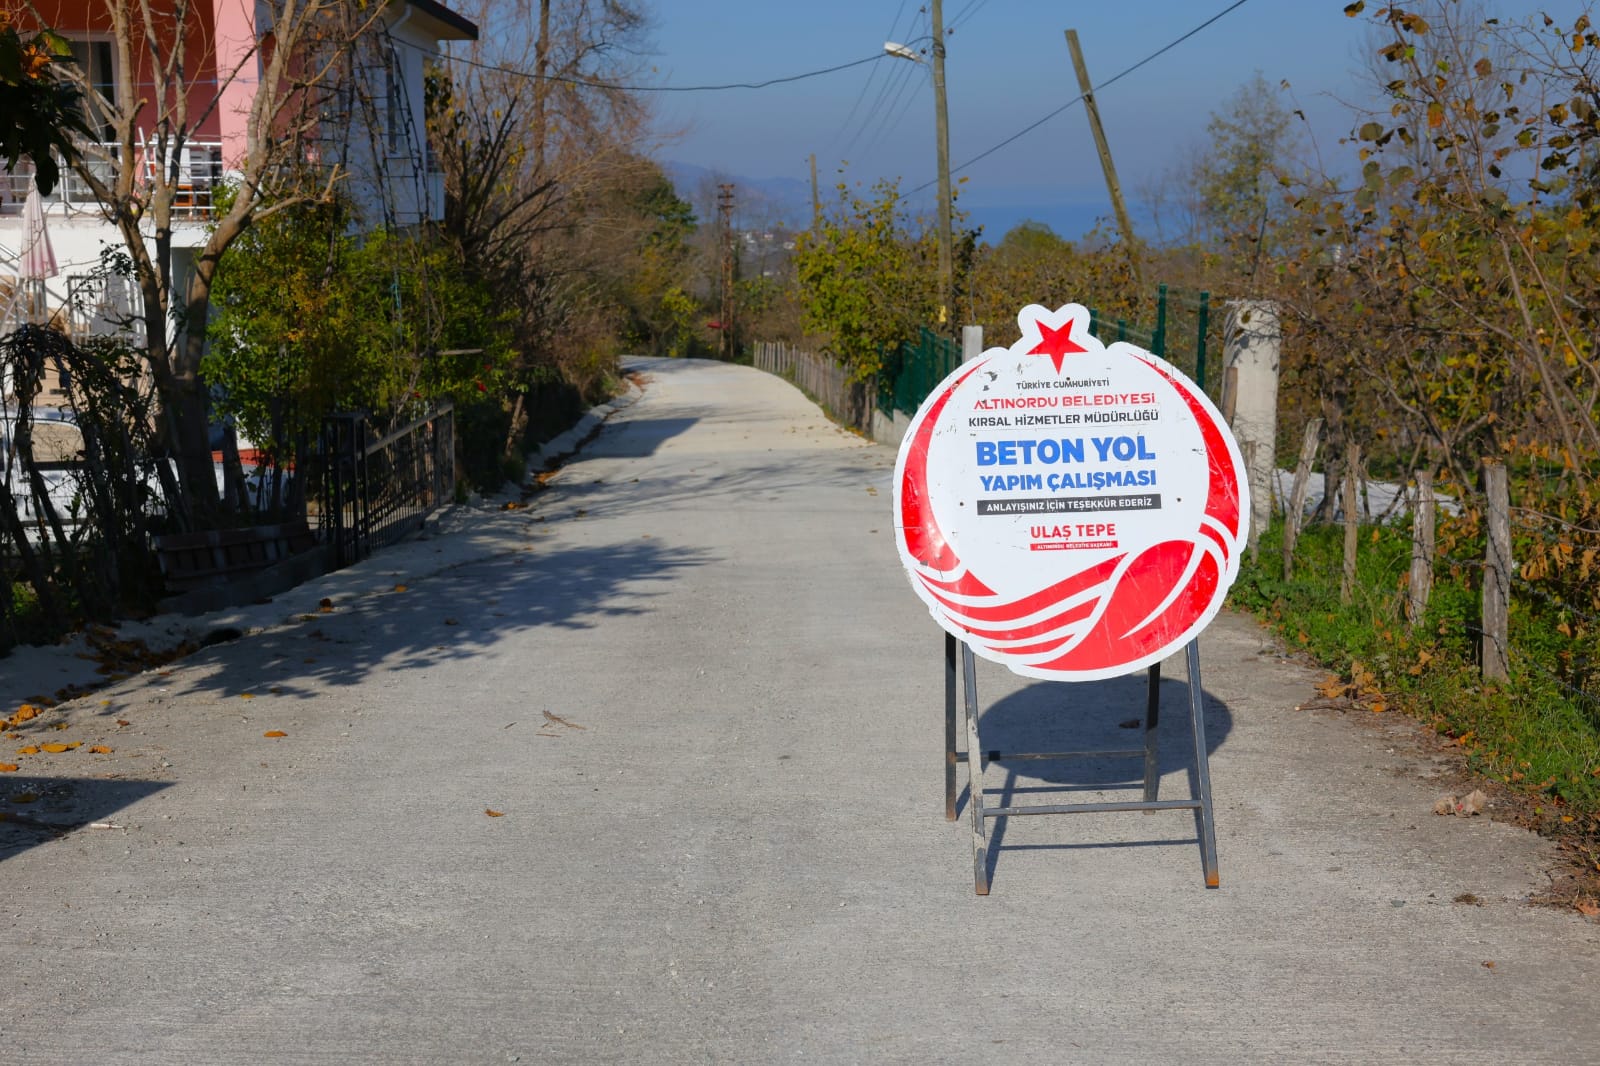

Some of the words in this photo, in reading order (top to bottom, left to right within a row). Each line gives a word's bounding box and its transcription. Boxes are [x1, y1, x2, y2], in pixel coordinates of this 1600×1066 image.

[1017, 380, 1050, 389] TÜRKİYE
[1054, 379, 1109, 388] CUMHURİYETİ
[974, 396, 1057, 409] ALTINORDU
[1063, 393, 1155, 406] BELEDİYESİ
[969, 416, 1011, 427] KIRSAL
[1015, 413, 1080, 425] HİZMETLER
[1084, 410, 1159, 423] MÜDÜRLÜĞÜ
[976, 439, 1084, 466] BETON
[1091, 436, 1156, 461] YOL
[980, 474, 1042, 491] YAPIM
[1047, 470, 1156, 492] ÇALIŞMASI
[987, 502, 1045, 512] ANLAYIŞINIZ
[1046, 500, 1065, 511] İÇİN
[1067, 499, 1116, 510] TEŞEKKÜR
[1119, 498, 1152, 507] EDERİZ
[1031, 525, 1071, 540] ULAŞ
[1076, 524, 1116, 537] TEPE
